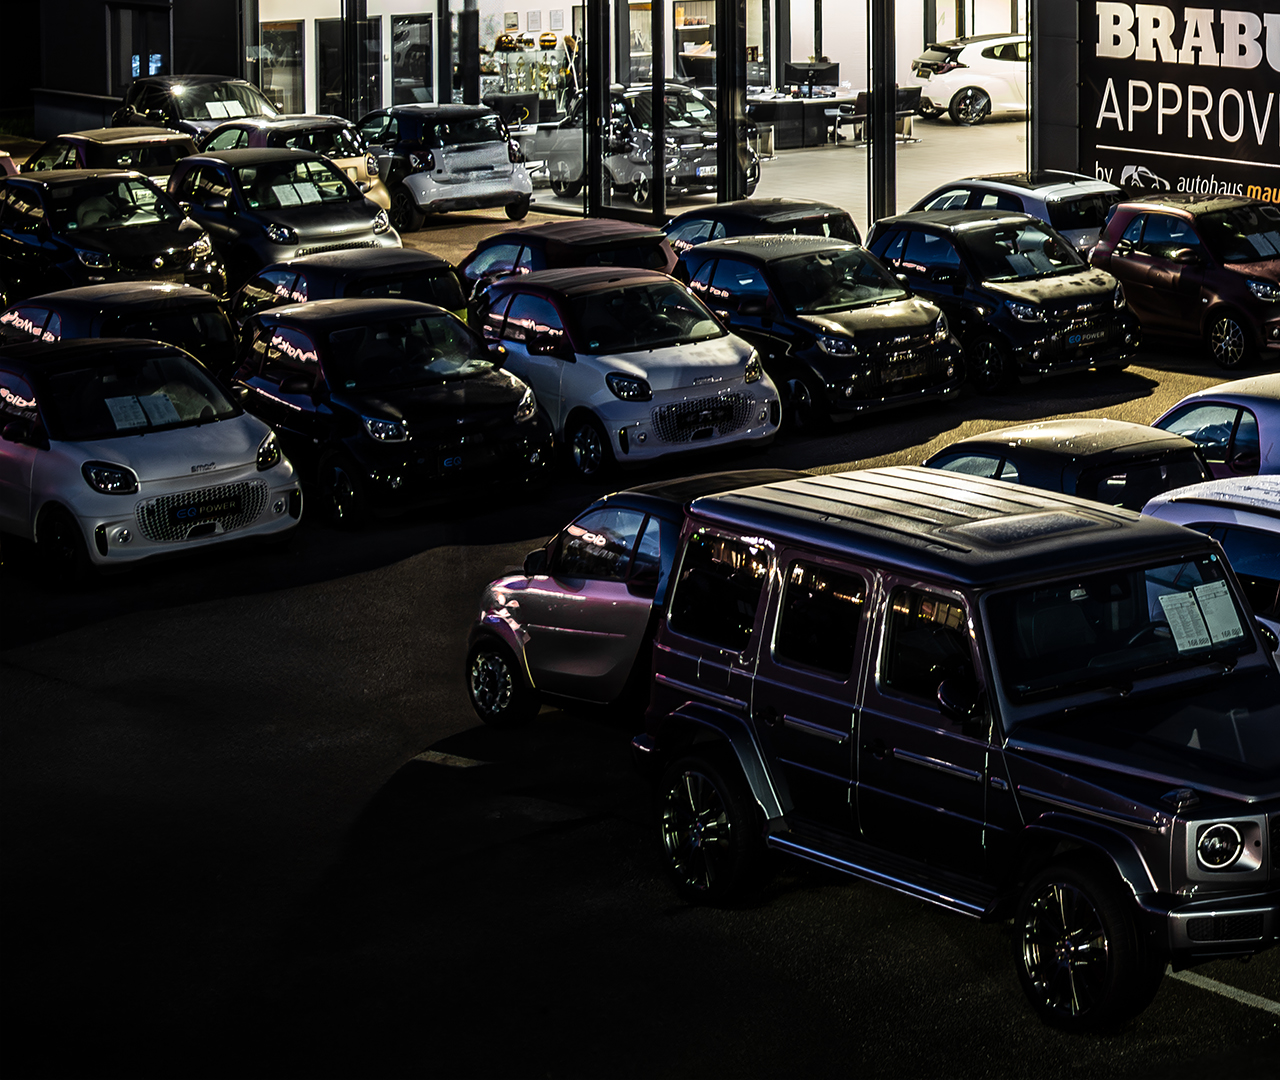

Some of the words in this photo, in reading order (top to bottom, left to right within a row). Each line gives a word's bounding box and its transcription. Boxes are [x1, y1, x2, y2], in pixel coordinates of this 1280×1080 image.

[1096, 161, 1113, 184] by
[1176, 174, 1244, 196] autohaus
[1082, 331, 1105, 341] POWER
[199, 500, 236, 514] POWER
